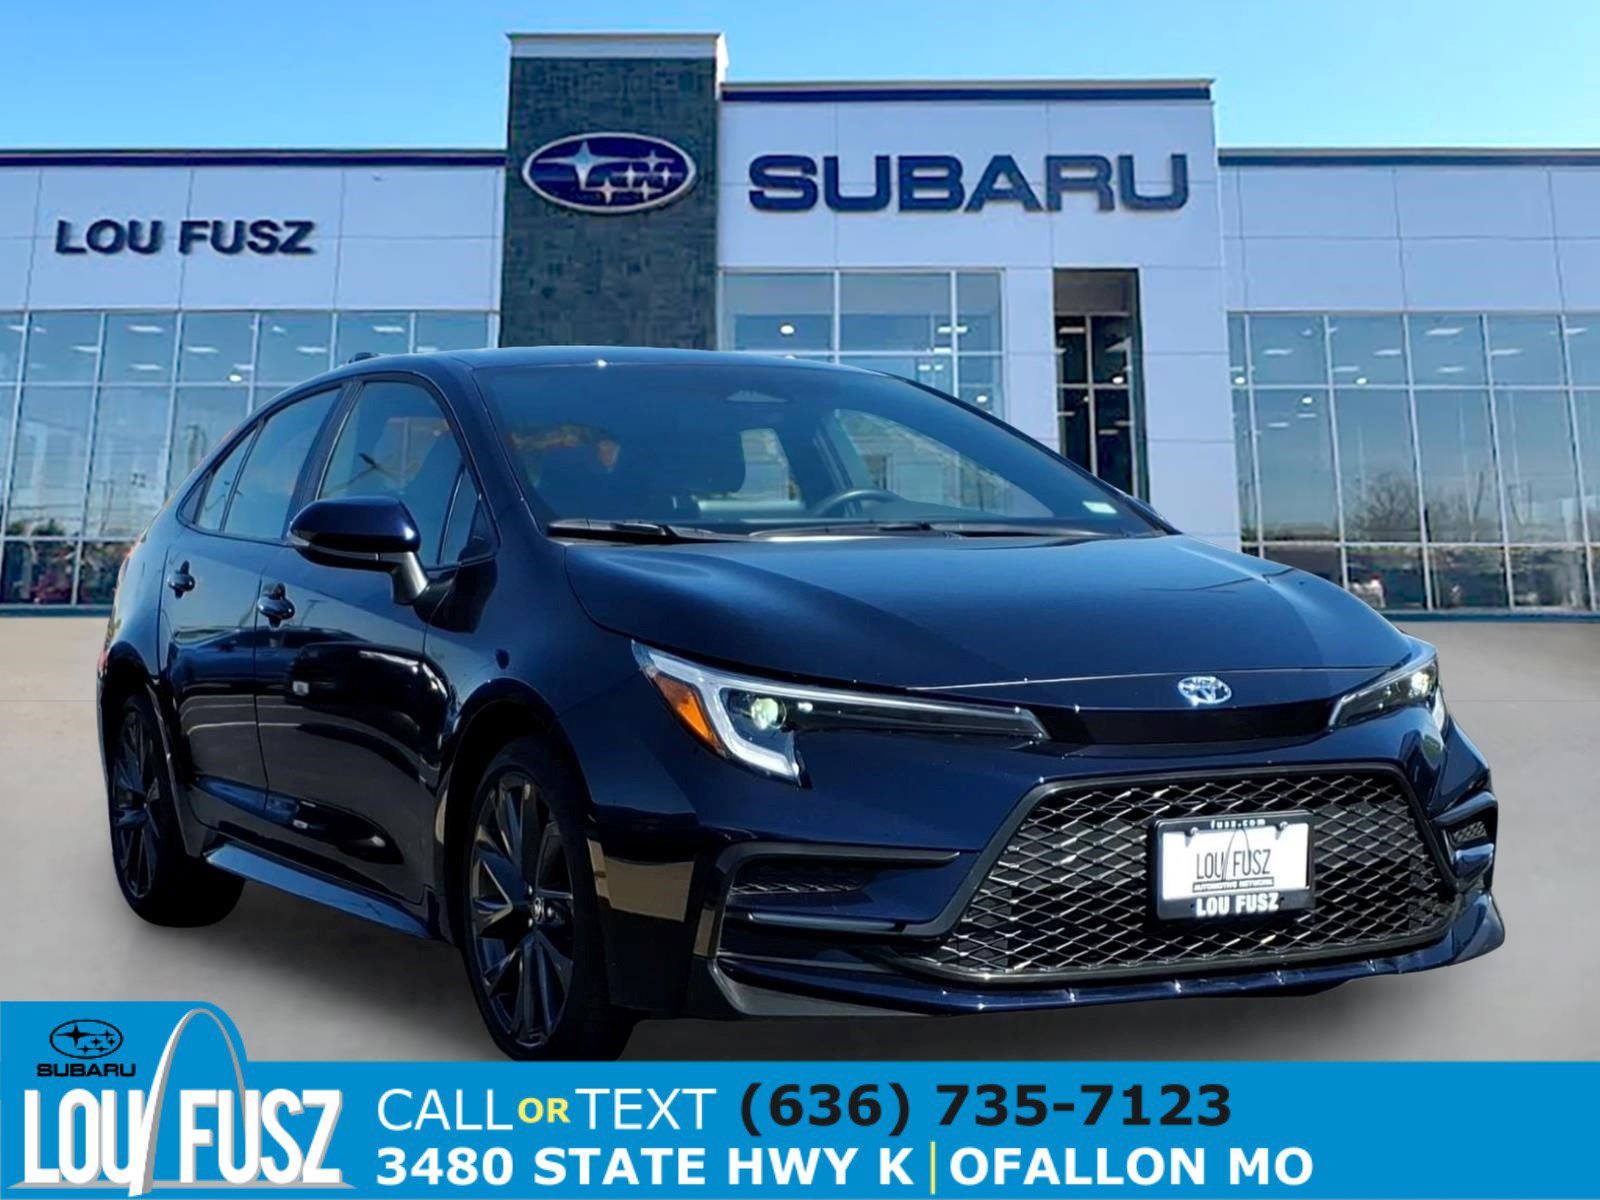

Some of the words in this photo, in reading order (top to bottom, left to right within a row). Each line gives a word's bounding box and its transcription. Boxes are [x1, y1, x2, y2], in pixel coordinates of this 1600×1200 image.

[748, 154, 1189, 212] SUBARU
[55, 219, 163, 255] LOU
[178, 219, 315, 255] FUSZ
[1210, 818, 1266, 830] fusz.com
[1196, 851, 1225, 880] LOU
[1232, 849, 1271, 877] FUSZ
[1195, 896, 1230, 918] LOU
[1234, 891, 1280, 915] FUSZ
